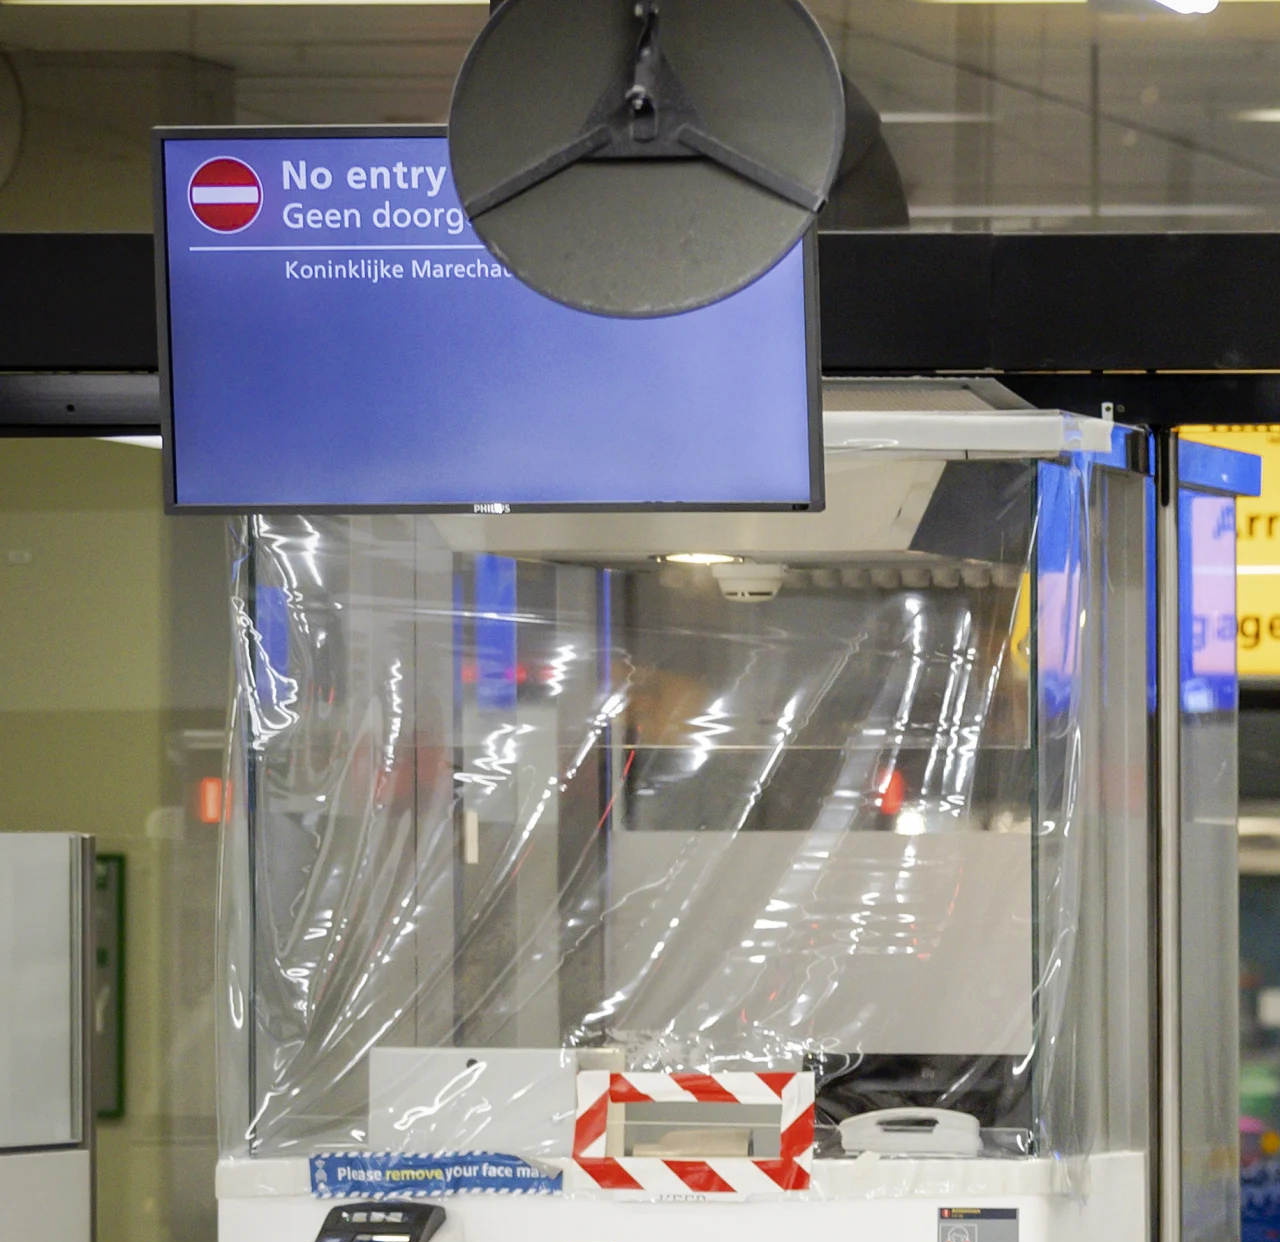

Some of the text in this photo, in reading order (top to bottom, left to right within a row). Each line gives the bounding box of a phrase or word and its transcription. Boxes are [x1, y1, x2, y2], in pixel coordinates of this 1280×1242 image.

[283, 161, 446, 197] No entry
[283, 201, 472, 234] Geen doorg
[286, 259, 403, 283] Koninklijke
[338, 1168, 382, 1181] Please
[385, 1169, 443, 1180] remove
[446, 1166, 478, 1182] your
[482, 1163, 513, 1177] face
